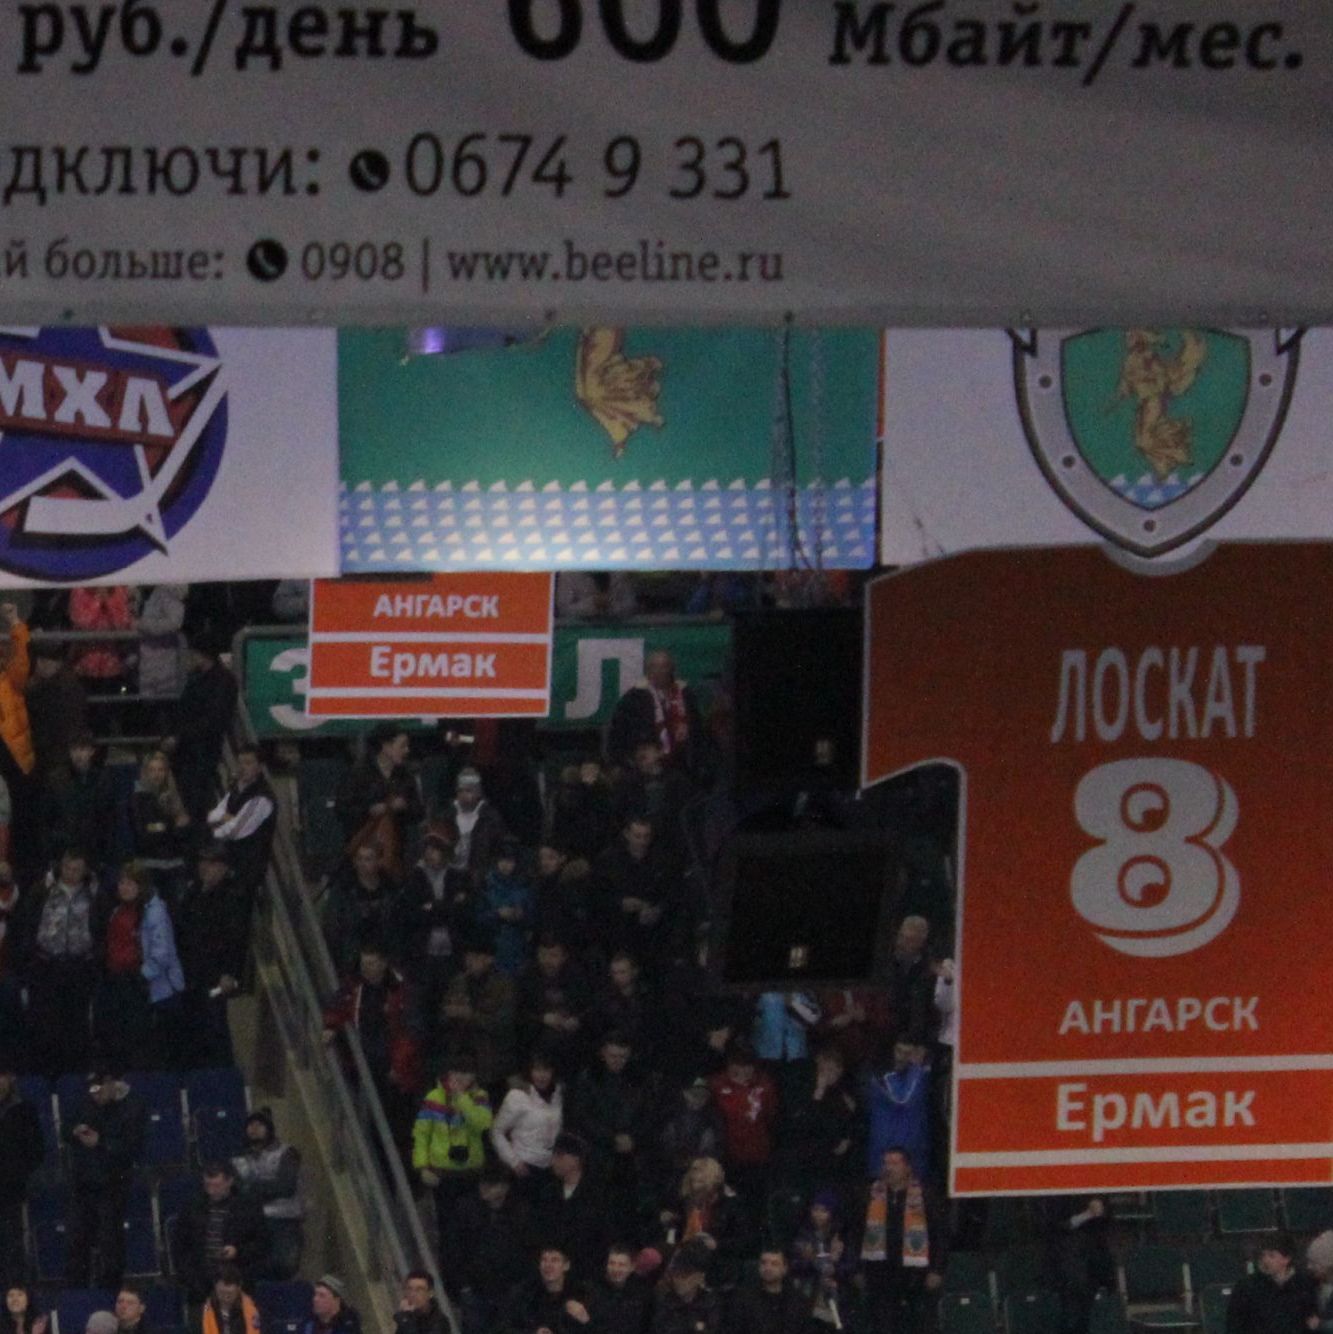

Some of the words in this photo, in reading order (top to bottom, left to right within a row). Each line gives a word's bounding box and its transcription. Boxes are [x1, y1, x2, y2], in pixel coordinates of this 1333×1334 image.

[829, 2, 1305, 87] Мбайт/мес.
[405, 133, 574, 198] 0674
[602, 135, 642, 199] 9
[670, 137, 793, 200] 331
[45, 236, 224, 282] больше:
[301, 242, 405, 282] 0908
[448, 241, 784, 284] www.beeline.ru
[373, 593, 499, 619] АНГАРСК
[370, 646, 496, 686] Ермак
[1050, 645, 1266, 743] ЛОСКАТ
[1070, 757, 1241, 958] 8
[1059, 996, 1259, 1035] АНГАРСК
[1055, 1083, 1257, 1142] Ермак
